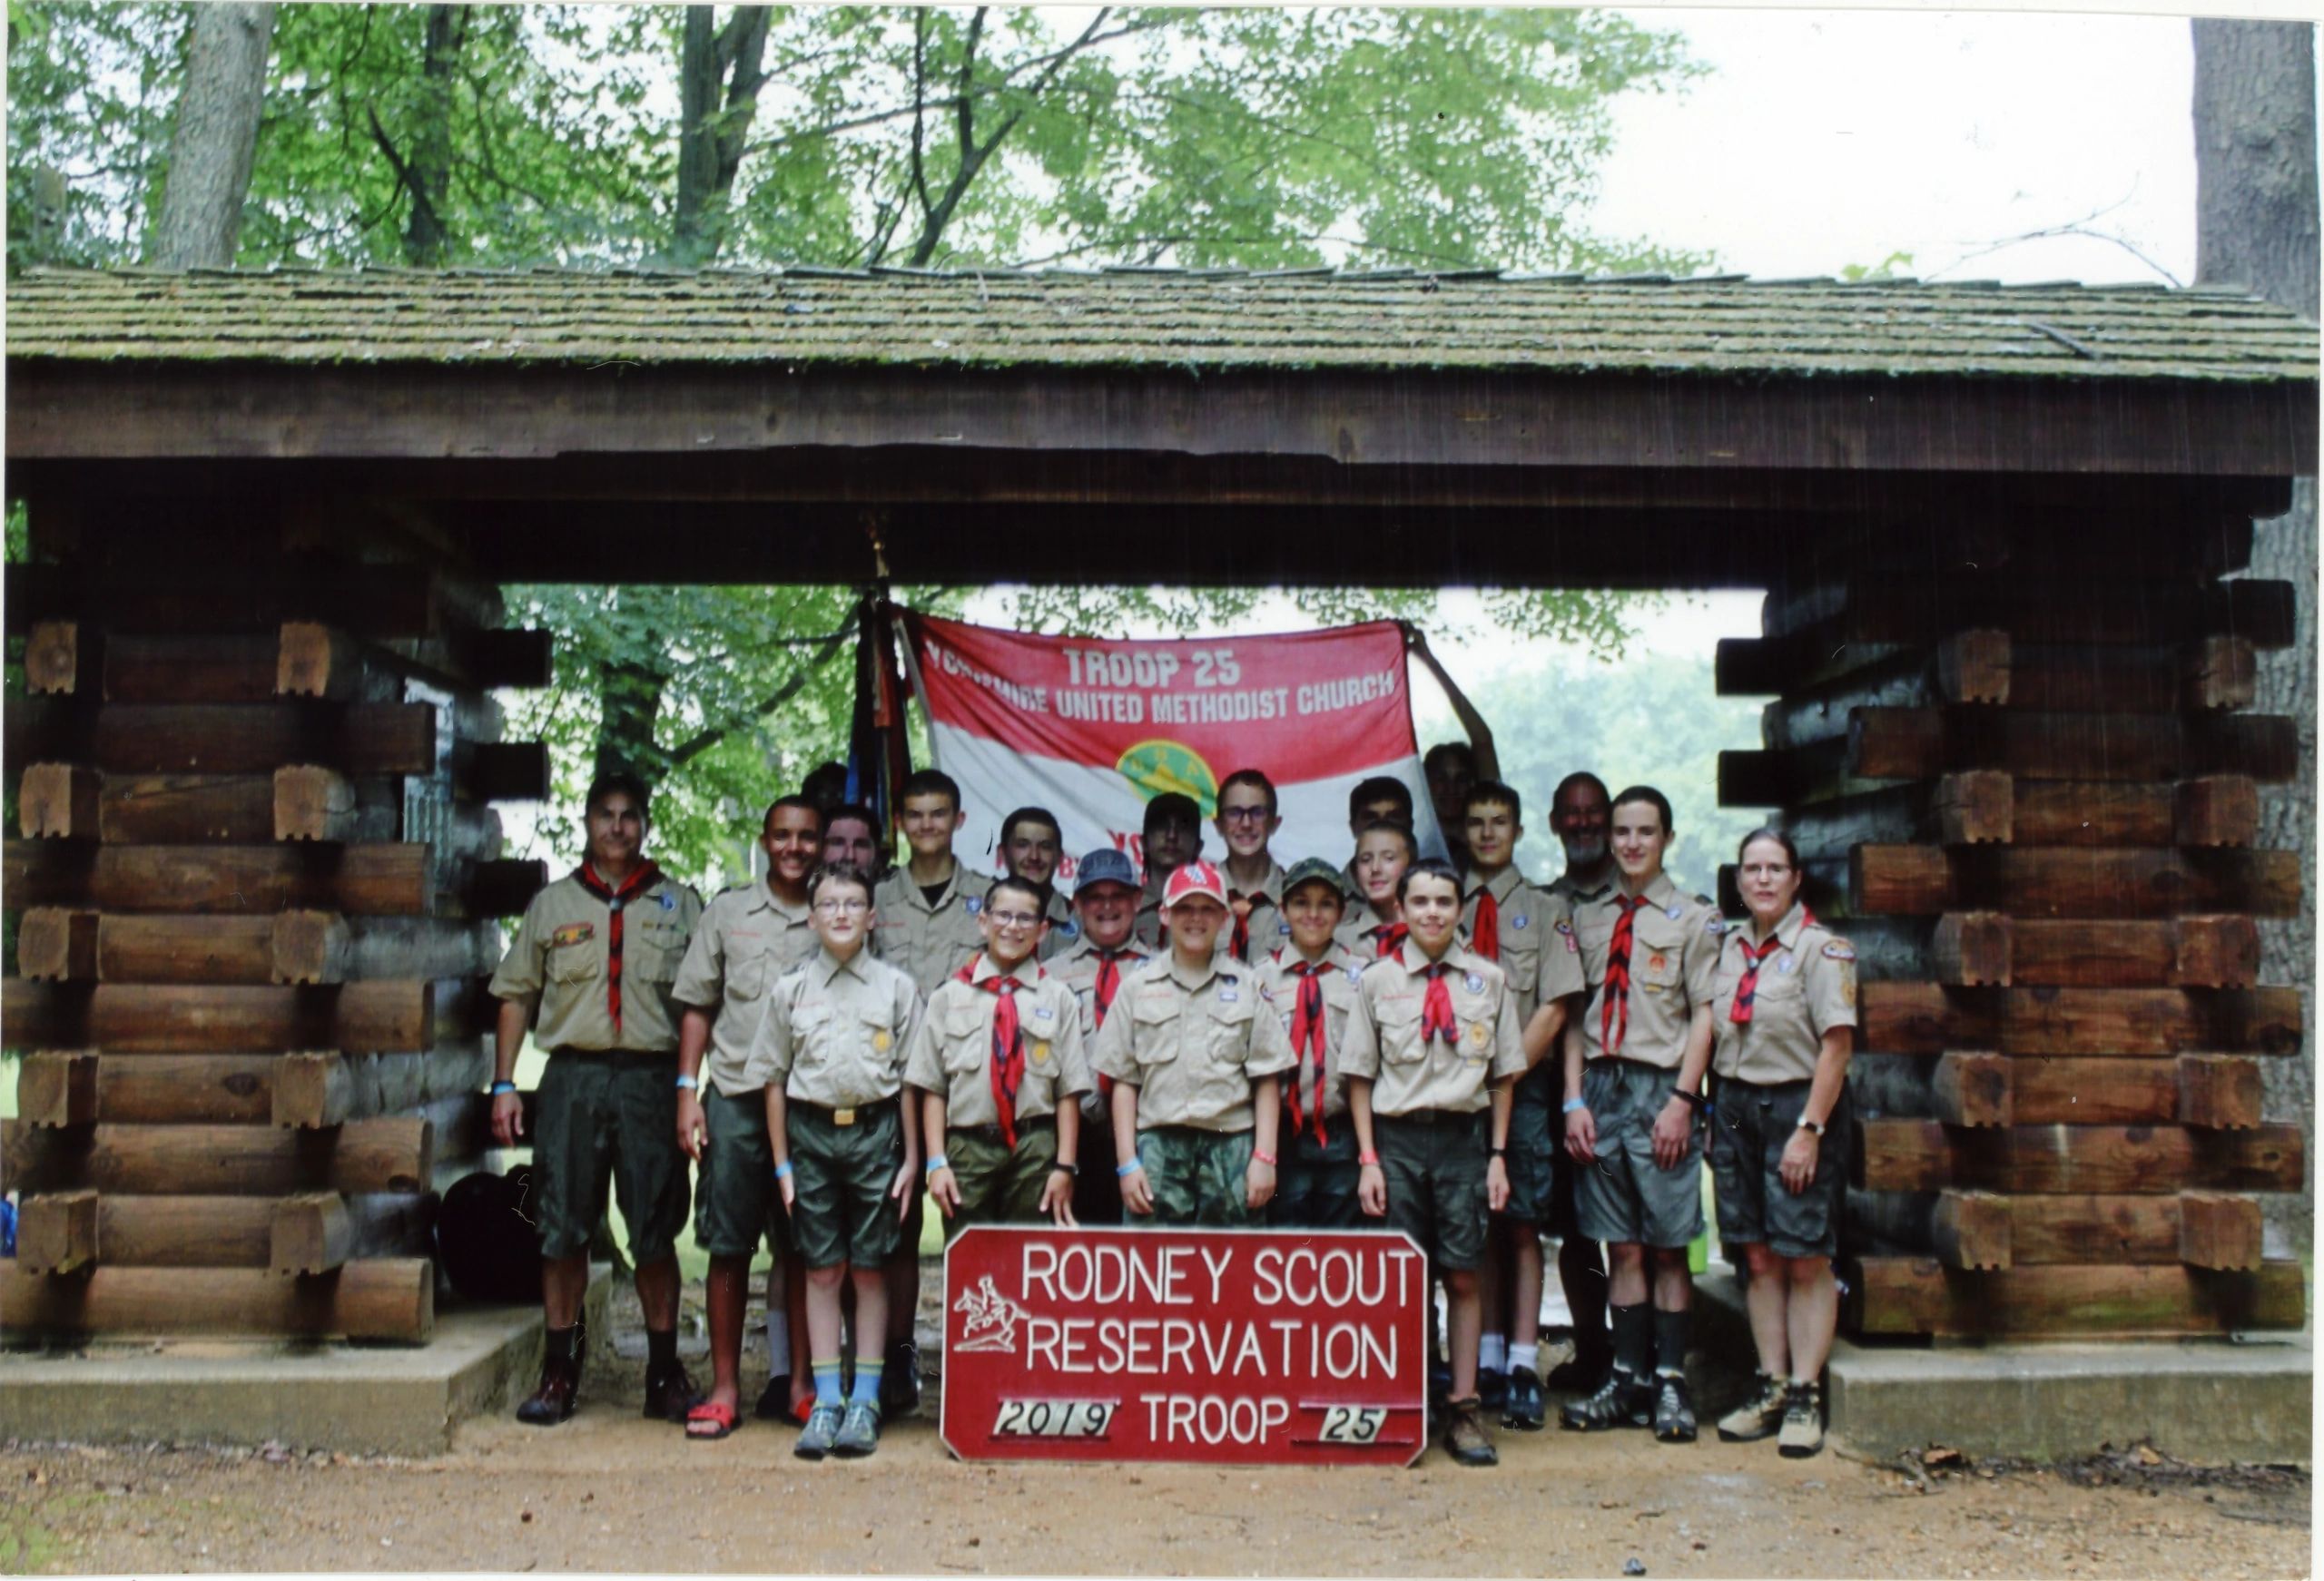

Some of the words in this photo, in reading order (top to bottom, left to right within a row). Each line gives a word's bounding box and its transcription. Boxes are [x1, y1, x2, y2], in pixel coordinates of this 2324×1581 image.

[1063, 647, 1179, 688] TROOP
[1191, 648, 1241, 688] 25
[1055, 690, 1144, 723] UNITED
[1151, 688, 1288, 724] METHODIST
[1296, 670, 1395, 717] CHURCH
[1022, 1242, 1234, 1304] RODNEY
[1253, 1248, 1417, 1308] SCOUT
[1026, 1318, 1397, 1380] RESERVATION
[1000, 1401, 1107, 1436] 2019
[1139, 1395, 1290, 1445] TROOP
[1324, 1407, 1383, 1441] 25
